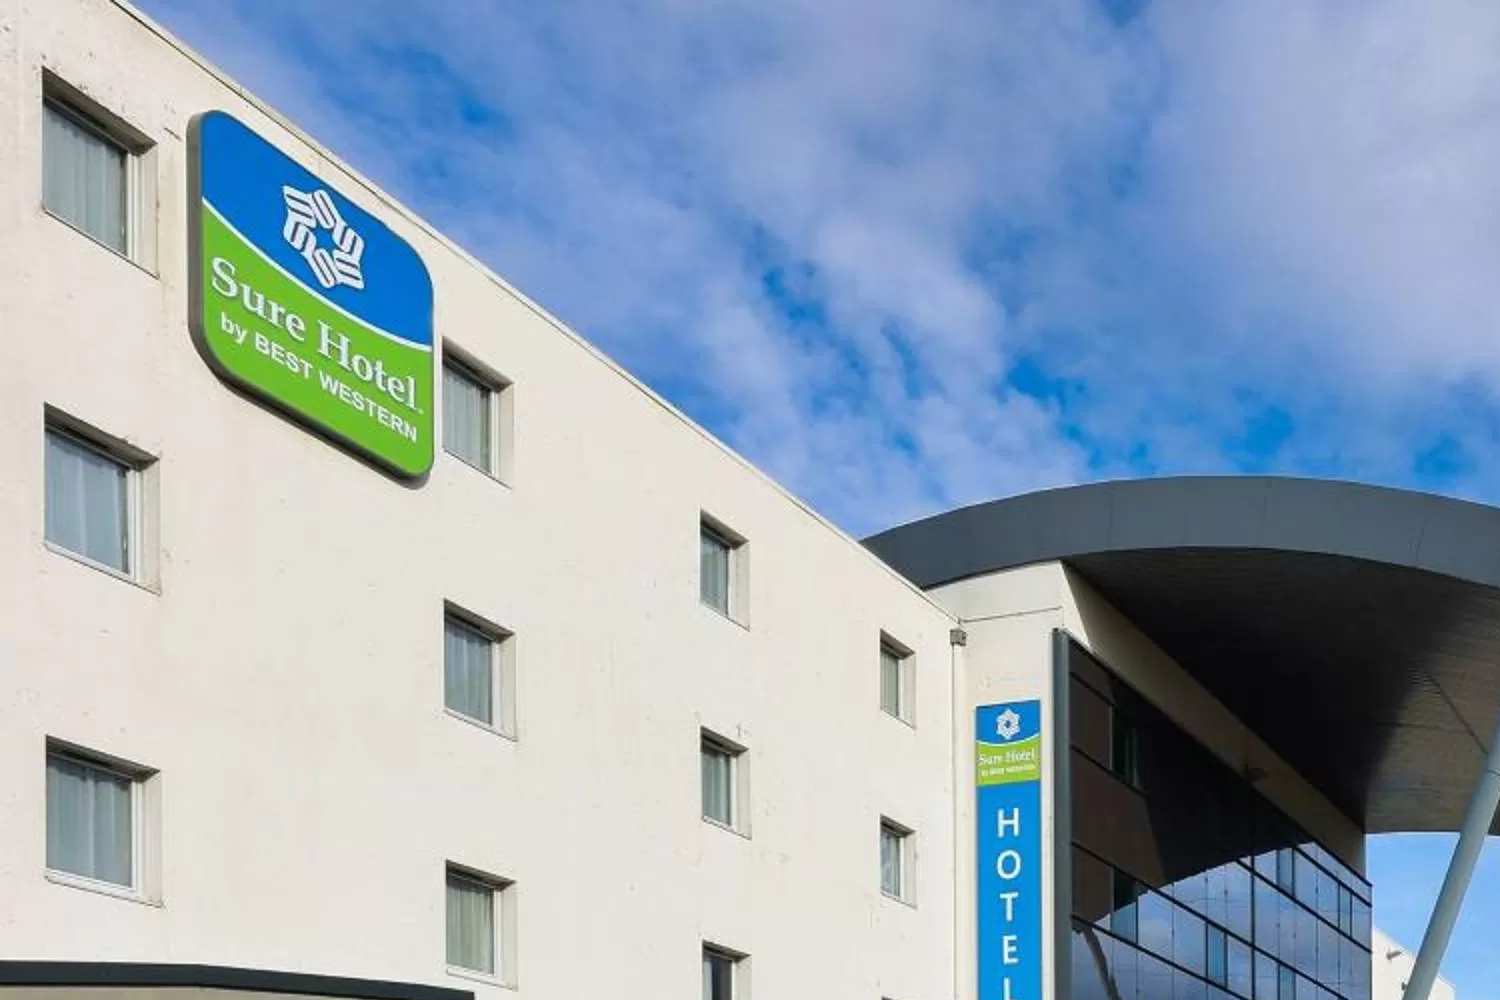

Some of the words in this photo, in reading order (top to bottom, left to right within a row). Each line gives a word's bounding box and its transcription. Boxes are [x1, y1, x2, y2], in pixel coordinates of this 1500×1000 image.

[211, 256, 305, 341] Sure
[317, 320, 418, 410] Hotel
[220, 312, 246, 344] by
[254, 333, 312, 380] BEST
[320, 371, 418, 443] WESTERN
